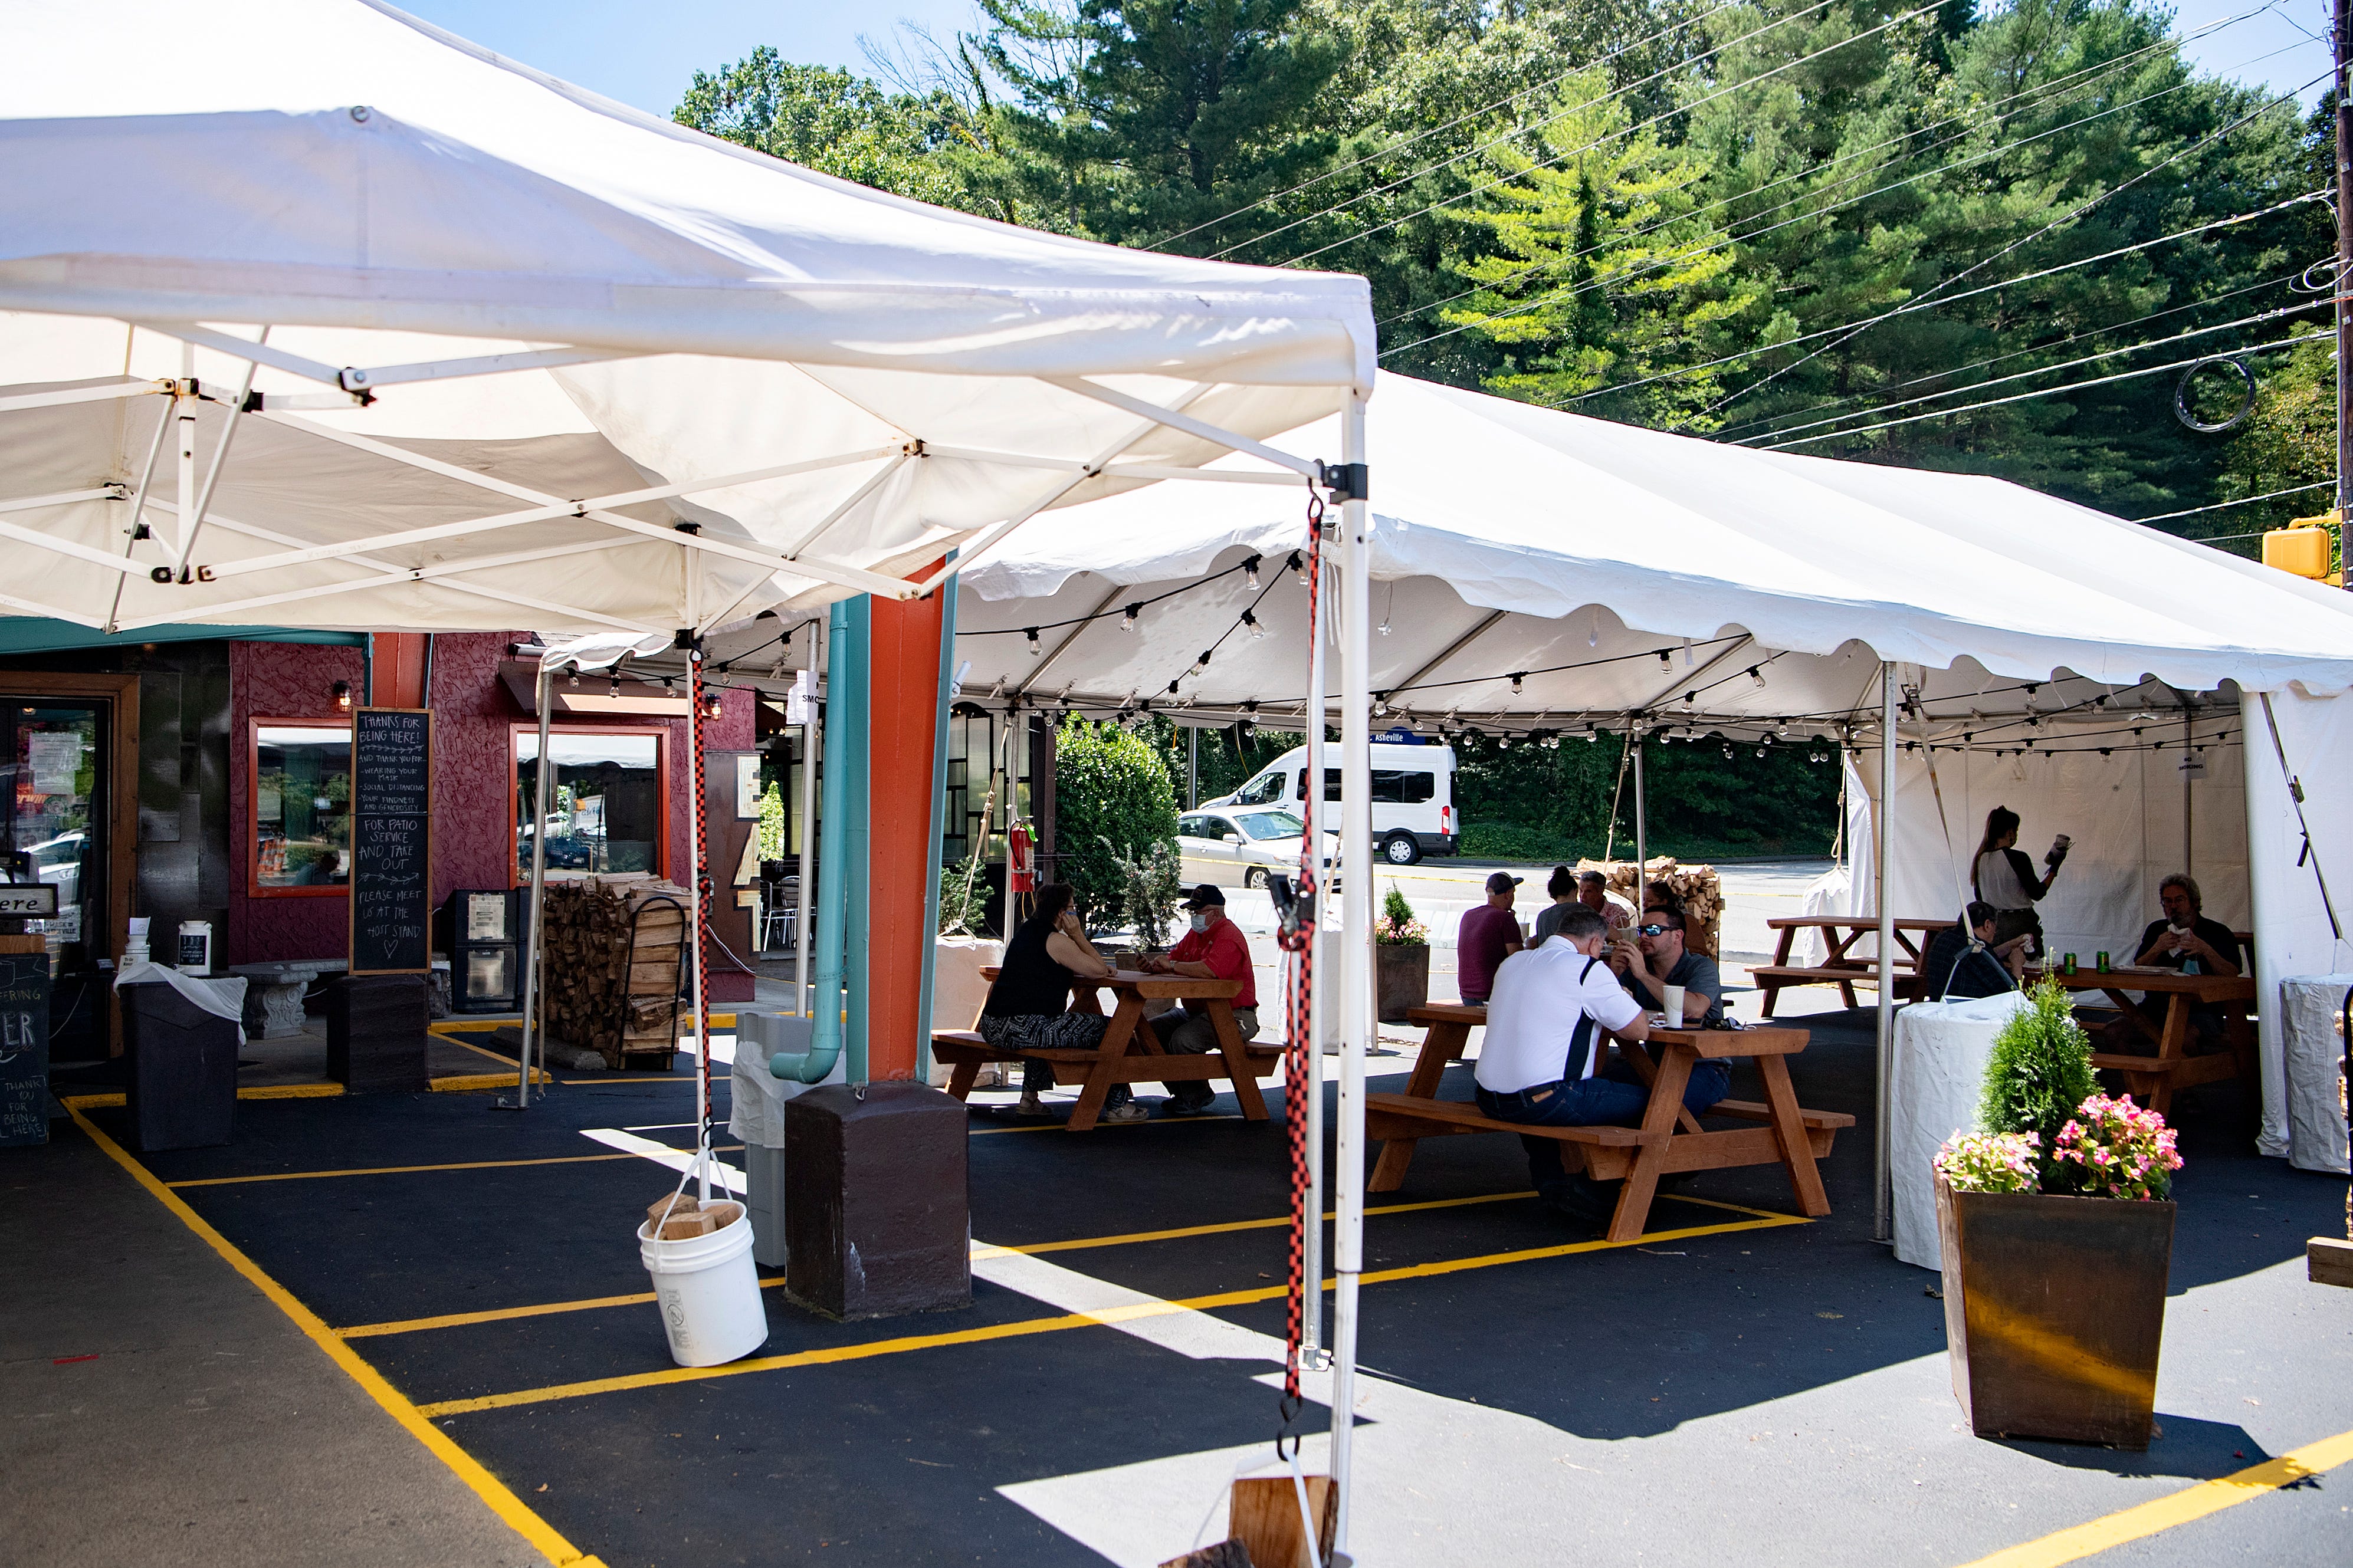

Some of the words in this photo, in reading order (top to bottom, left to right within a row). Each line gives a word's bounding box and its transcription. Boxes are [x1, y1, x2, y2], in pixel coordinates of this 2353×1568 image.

[360, 715, 399, 729] THANKS
[402, 717, 420, 729] FOR
[359, 730, 387, 743] BEING
[390, 731, 419, 744] HERE!
[1375, 733, 1403, 742] Asheville
[359, 755, 373, 764] AND
[365, 818, 385, 831] FOR
[389, 818, 418, 831] PATIO
[369, 831, 409, 844] SERVICE
[359, 846, 384, 860] AND
[390, 845, 414, 858] TAKE
[382, 857, 409, 870] OUT
[359, 890, 392, 905] PLEASE
[396, 890, 422, 901] MEET
[363, 906, 373, 919] US
[377, 906, 390, 918] AT
[395, 907, 409, 919] THE
[367, 925, 389, 938] HOST
[392, 925, 421, 938] STAND
[4, 1080, 42, 1092] THANK
[19, 1091, 34, 1100] YOU
[9, 1102, 28, 1112] FOR
[4, 1113, 36, 1125] BEING
[13, 1123, 42, 1136] HERE
